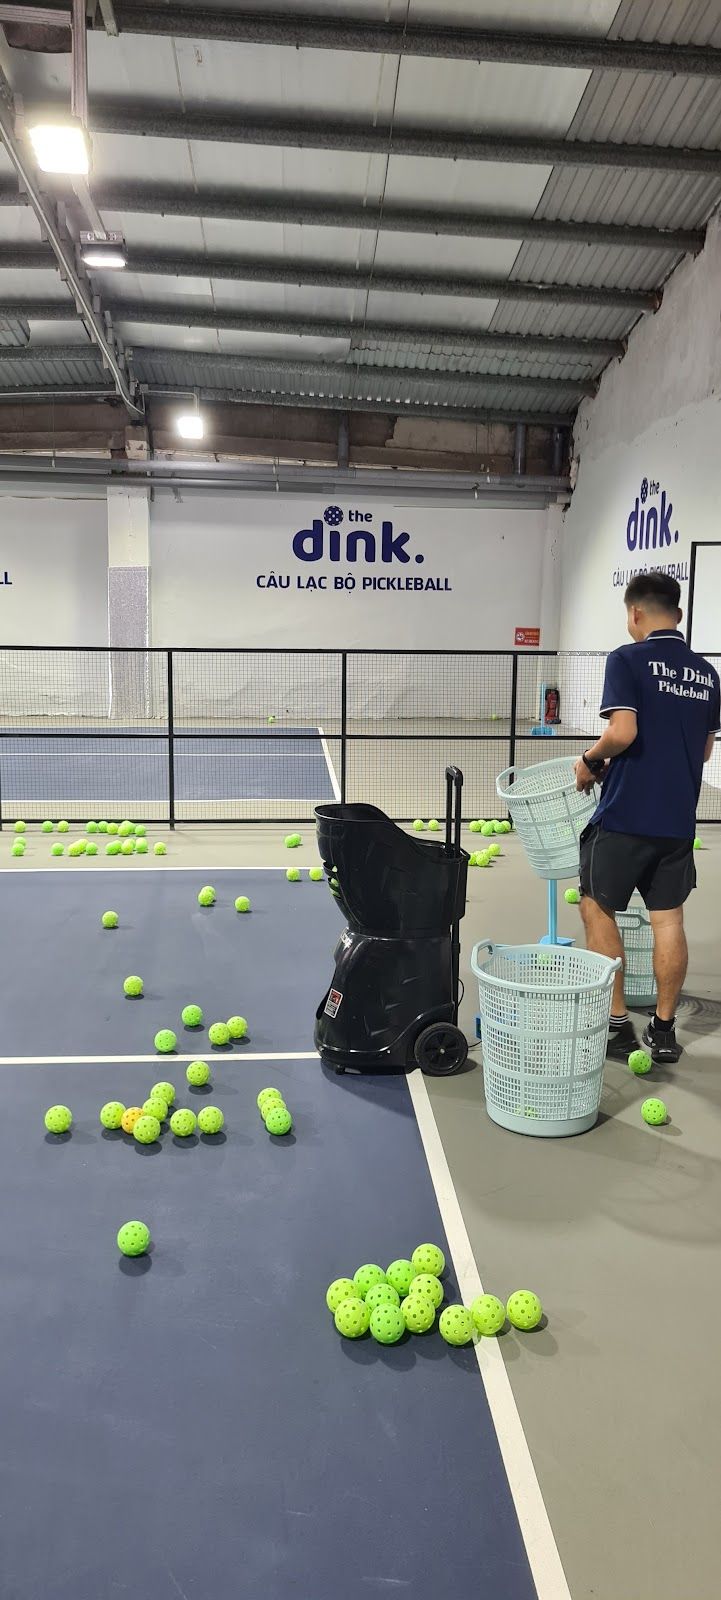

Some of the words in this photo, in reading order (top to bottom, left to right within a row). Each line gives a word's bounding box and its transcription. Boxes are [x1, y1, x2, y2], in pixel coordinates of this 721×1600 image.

[649, 479, 660, 496] the
[348, 509, 373, 522] the
[626, 490, 679, 552] dink.
[292, 519, 425, 564] dink.
[256, 571, 290, 588] CÂU
[297, 576, 327, 592] LẠC
[334, 572, 356, 594] BỘ
[362, 577, 452, 591] PICKLEBALL
[650, 562, 688, 581] EBALL
[648, 661, 677, 679] The
[681, 667, 714, 688] Dink
[658, 680, 709, 701] Pickleball
